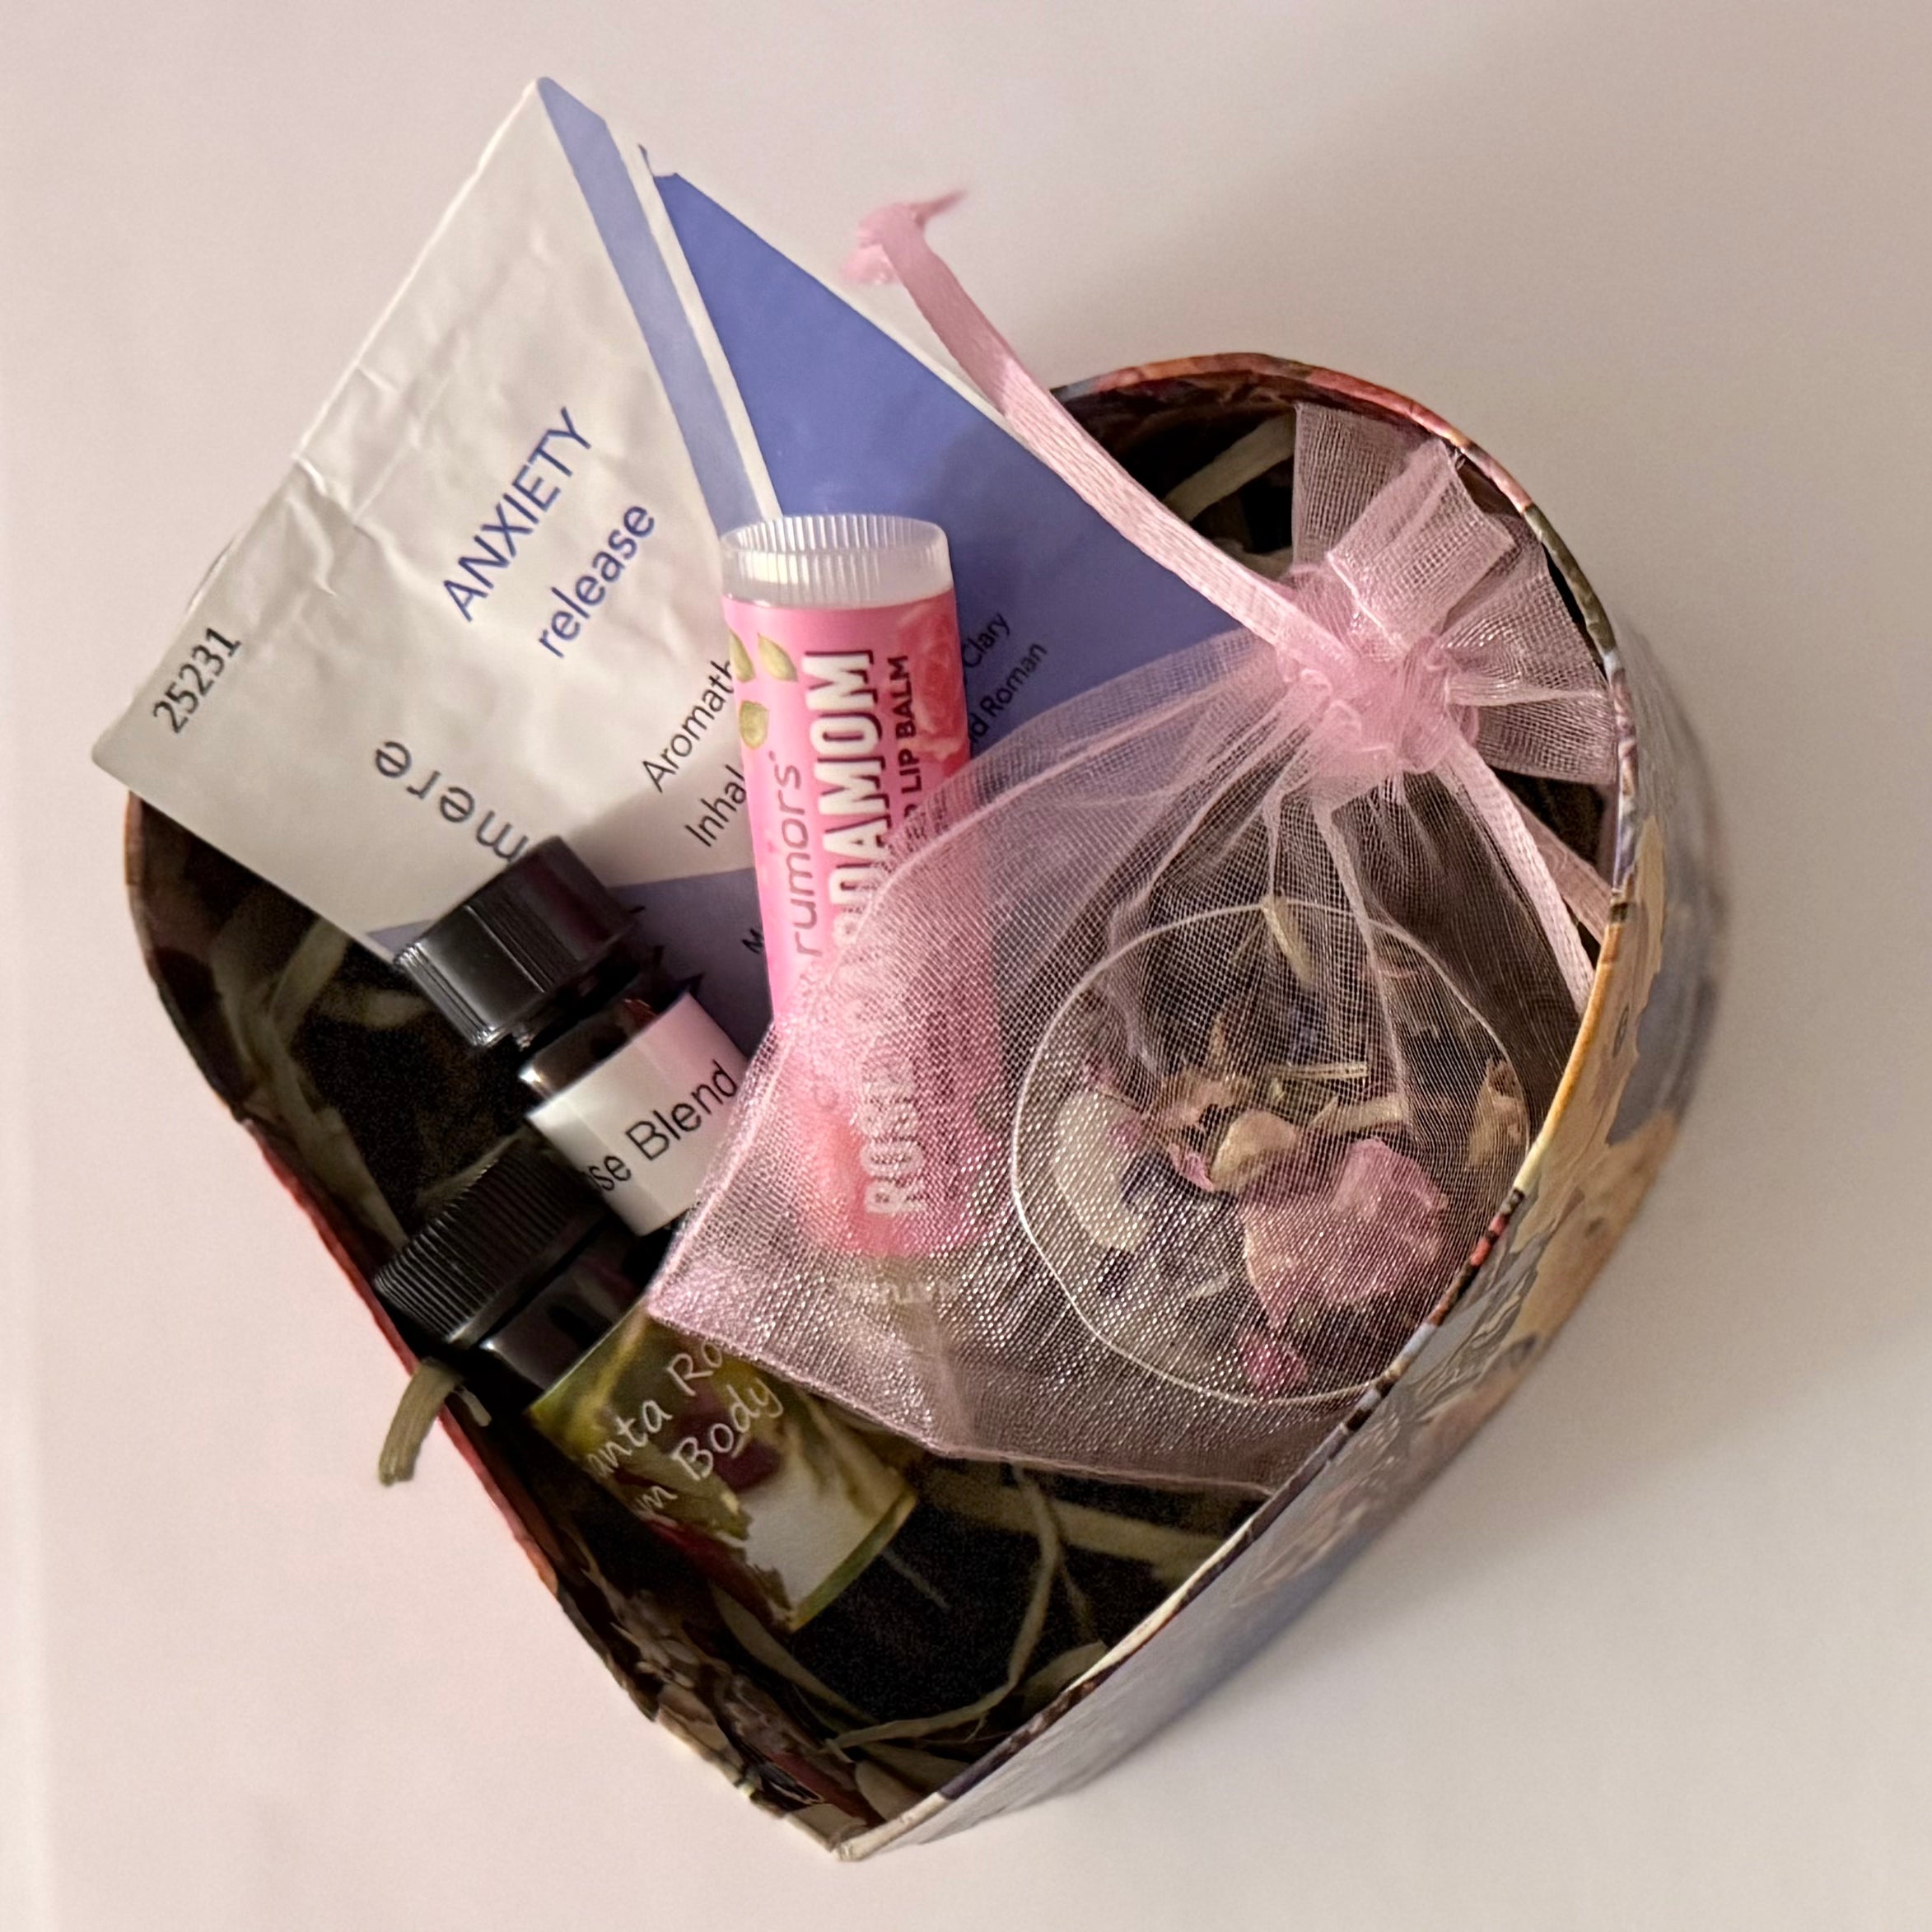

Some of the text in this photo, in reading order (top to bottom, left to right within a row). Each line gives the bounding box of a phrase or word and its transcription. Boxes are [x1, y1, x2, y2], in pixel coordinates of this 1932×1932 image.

[442, 407, 592, 622] ANXIETY
[539, 505, 656, 658] release
[152, 628, 242, 734] 25231
[962, 613, 1010, 668] Clary
[980, 643, 1048, 717] Roman
[887, 656, 917, 739] BALM
[897, 748, 922, 794] LIP
[626, 1059, 738, 1161] Blend
[670, 1377, 783, 1481] Body
